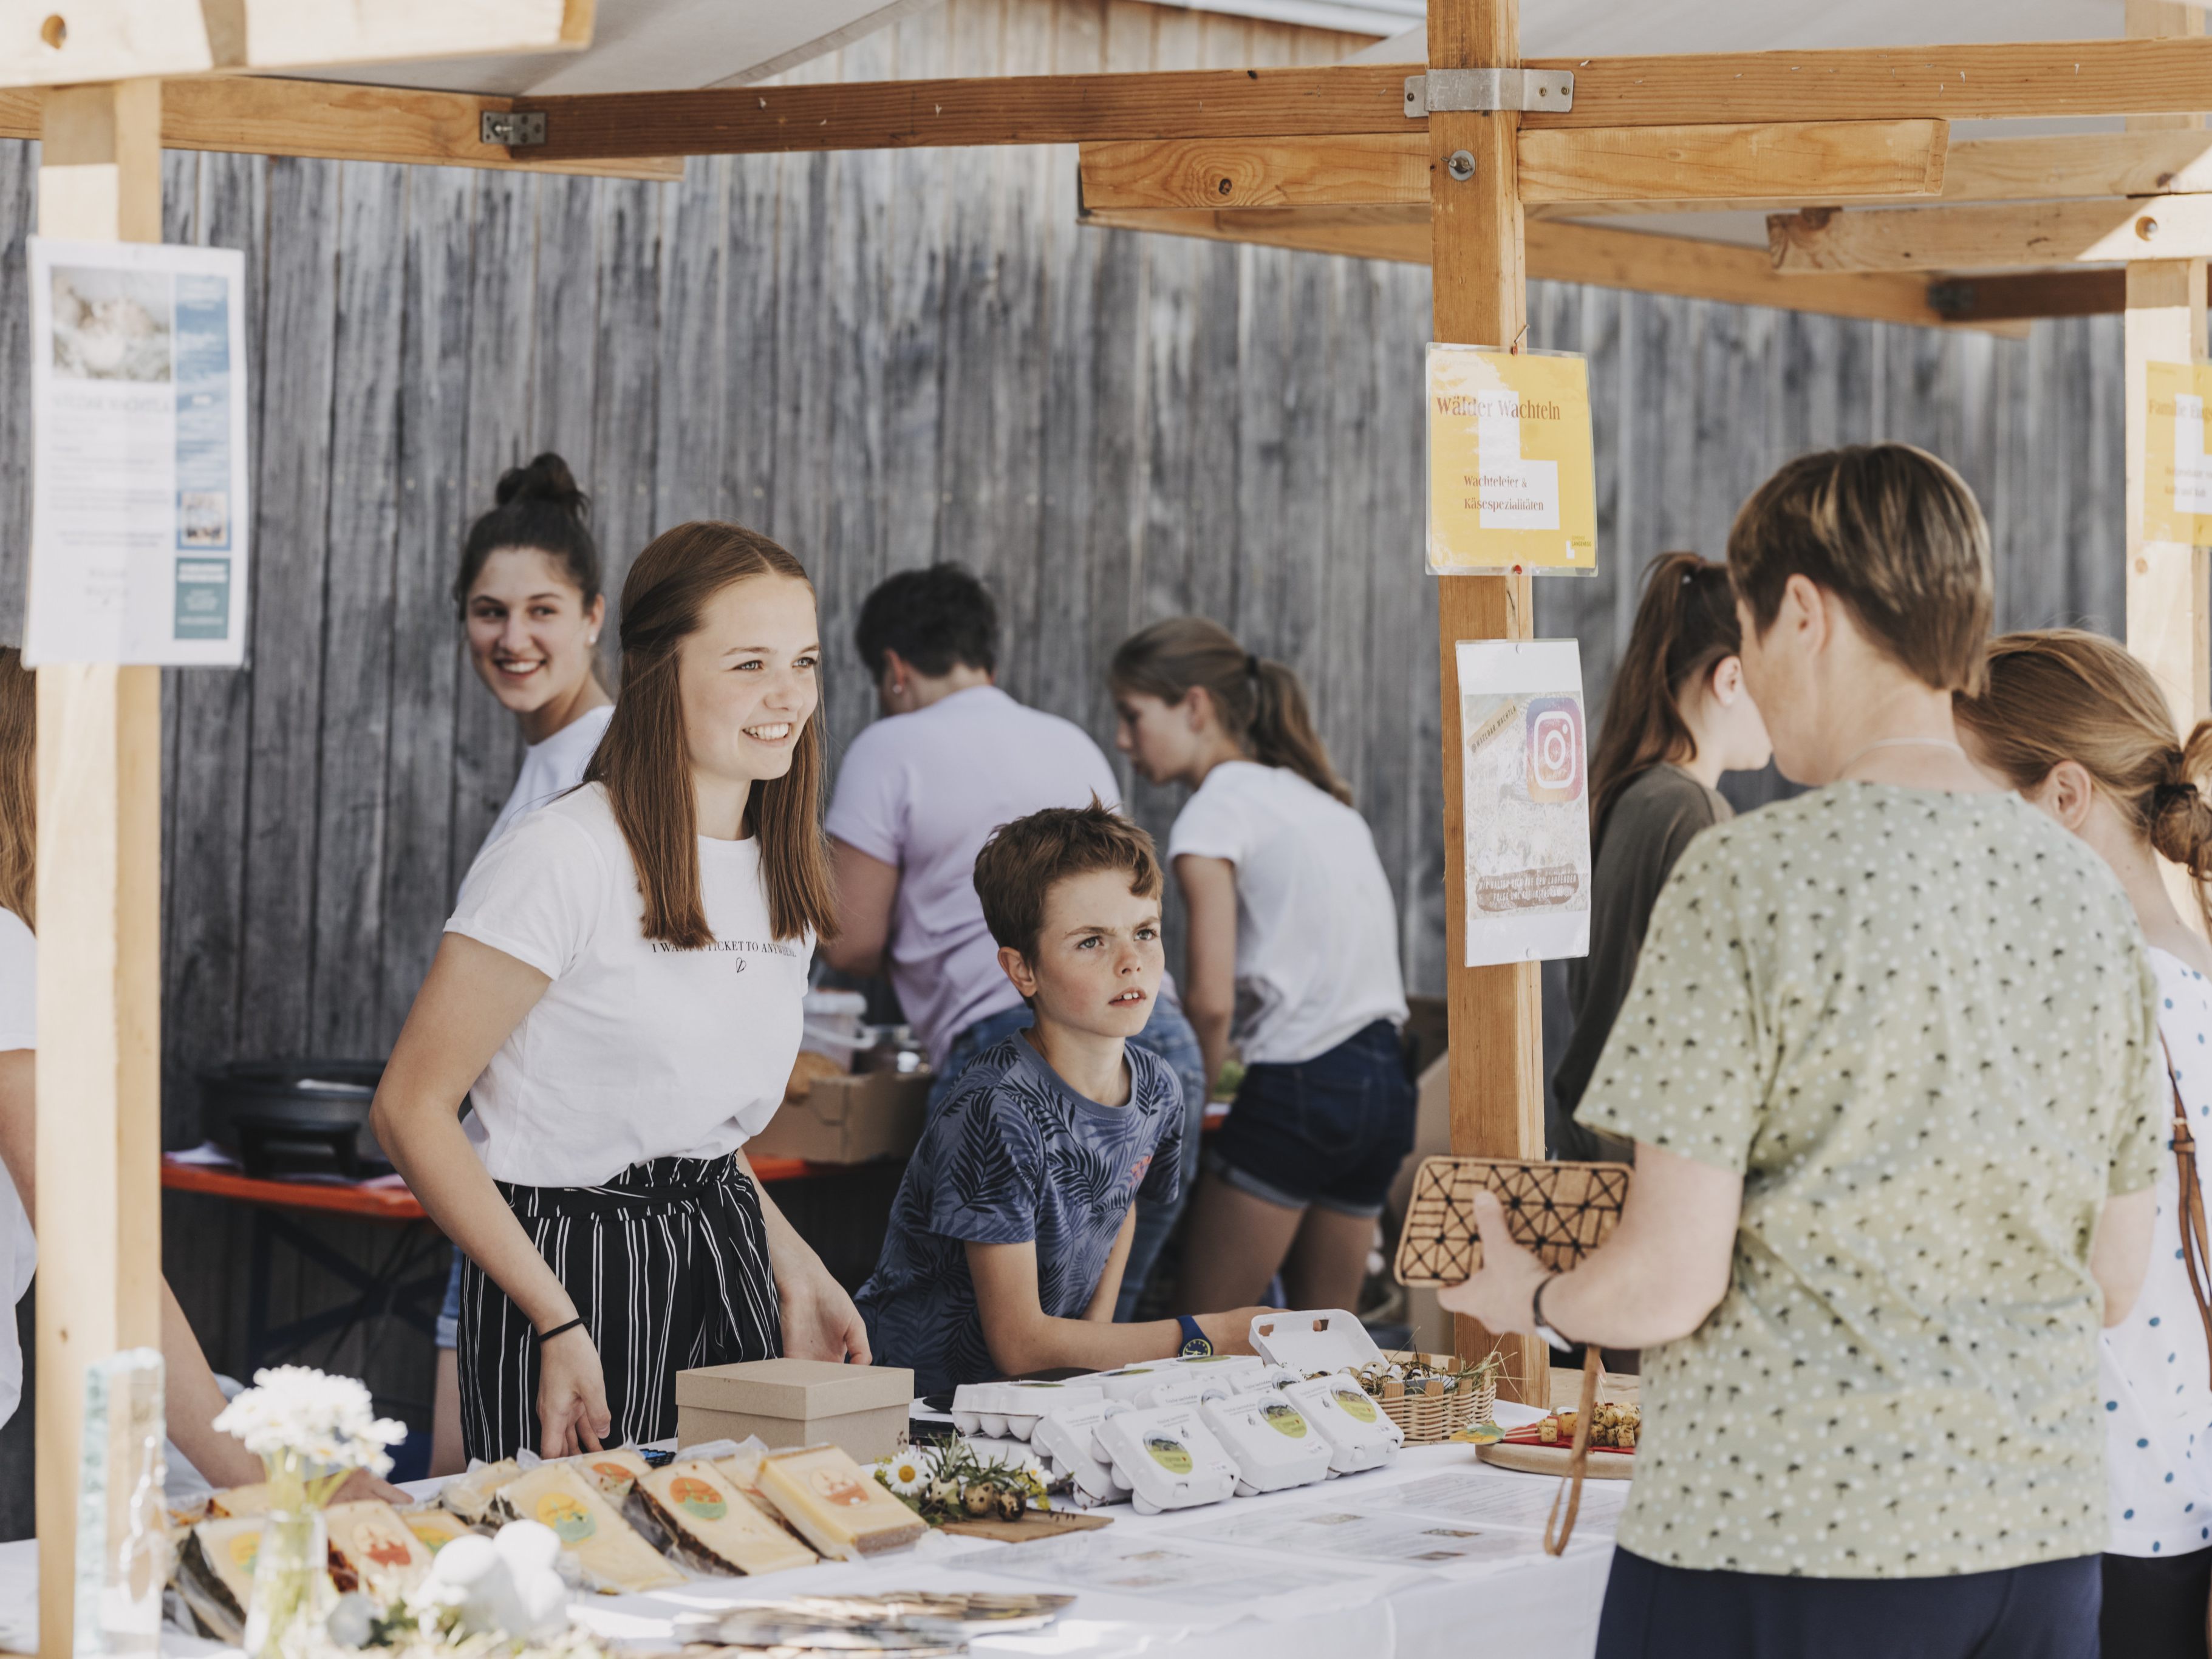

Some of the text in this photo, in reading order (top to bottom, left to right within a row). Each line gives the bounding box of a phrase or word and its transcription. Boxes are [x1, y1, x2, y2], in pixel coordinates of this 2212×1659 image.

[1437, 397, 1560, 420] Wälder Wachteln
[1464, 475, 1528, 488] Wachteleier &
[1464, 498, 1544, 513] Käsespezialitäten
[1548, 874, 1576, 885] LAUFENDEN
[652, 943, 657, 953] I
[708, 941, 744, 952] TICKET
[746, 942, 759, 952] TO
